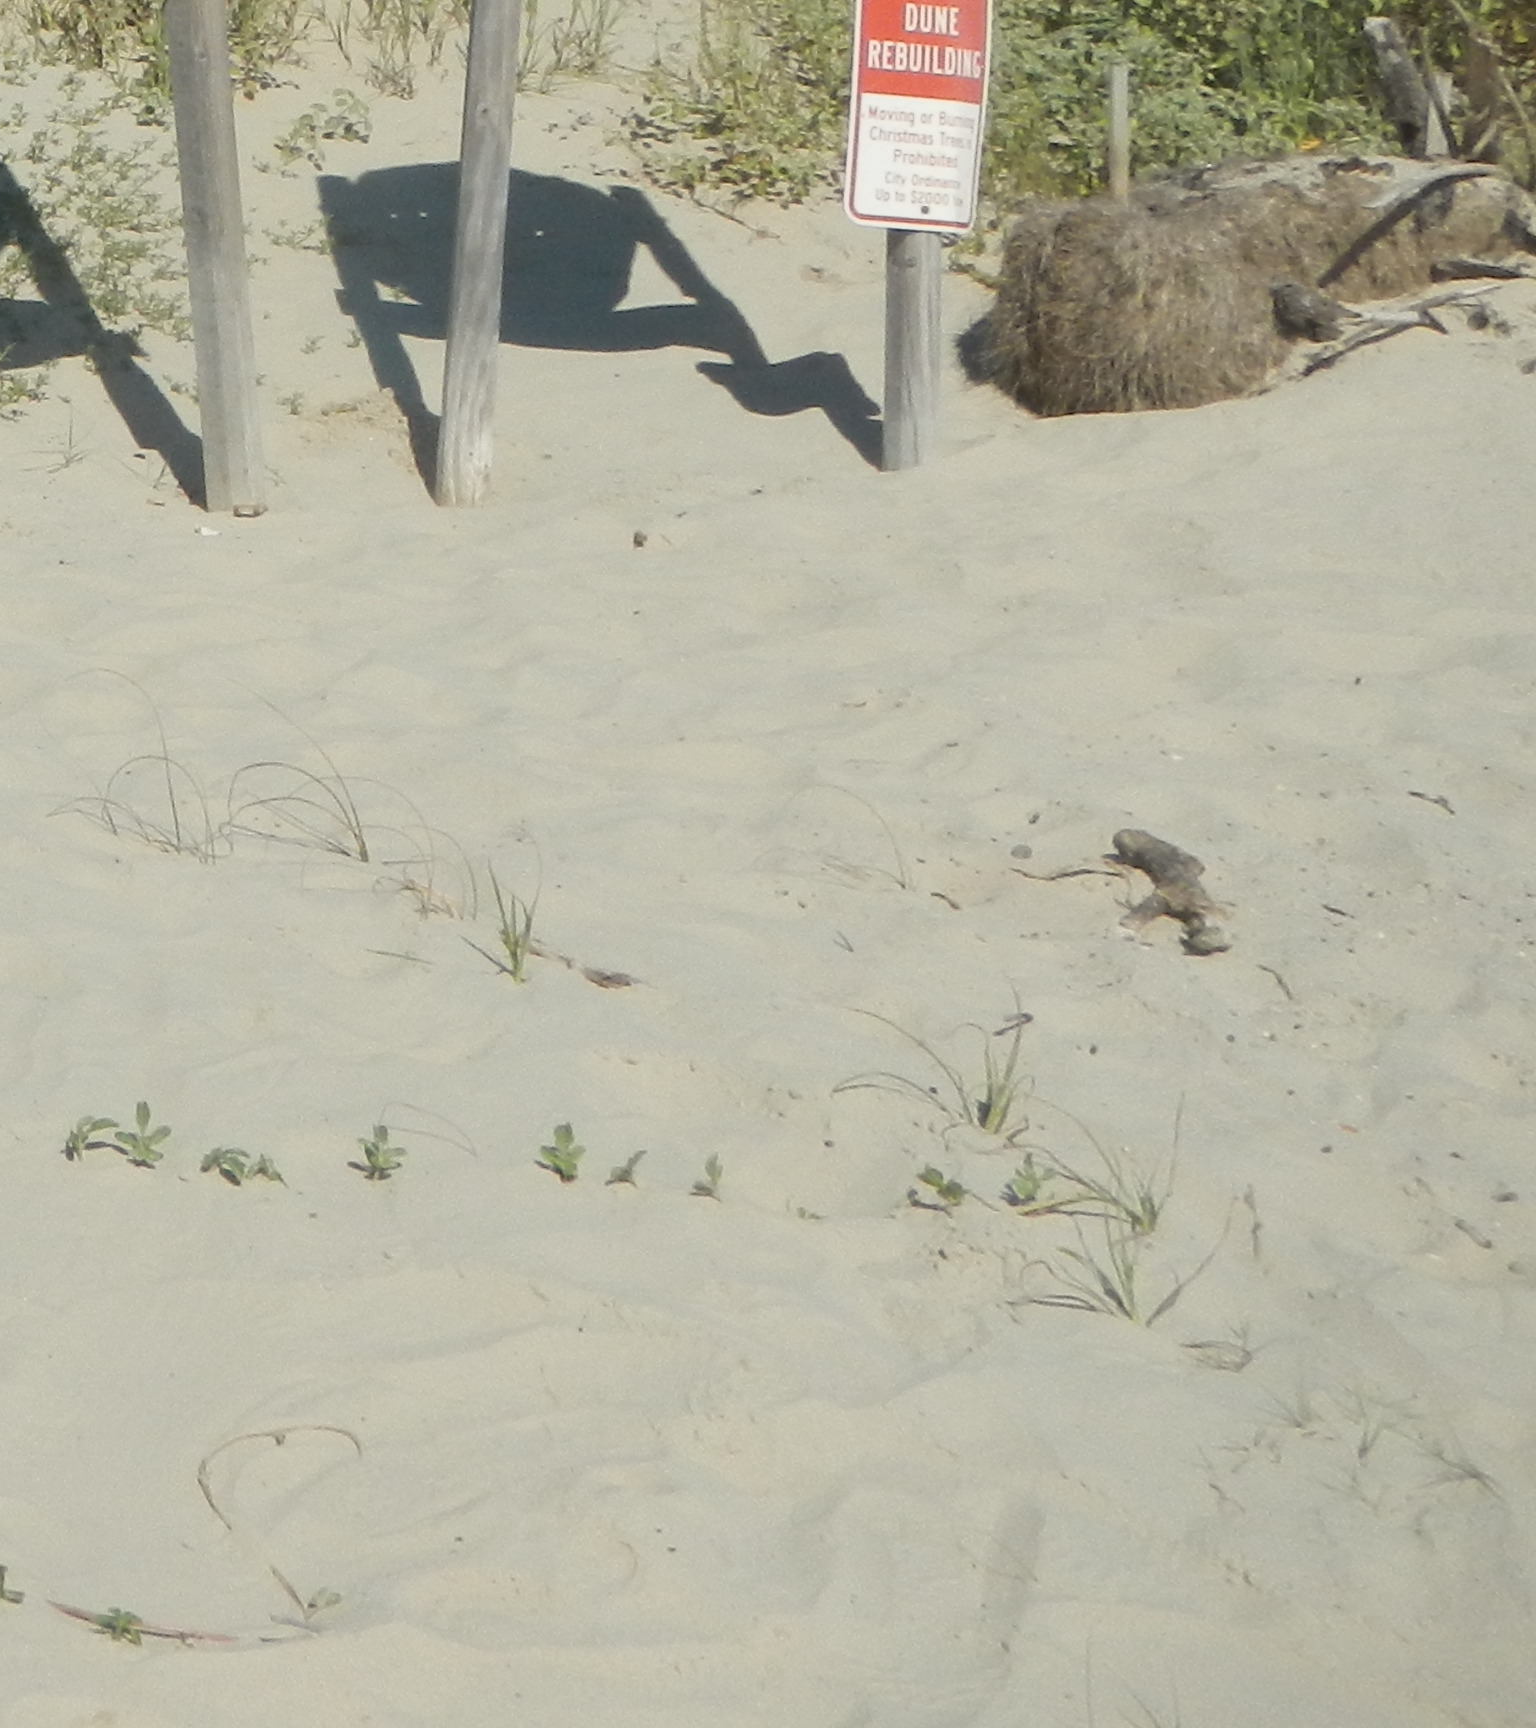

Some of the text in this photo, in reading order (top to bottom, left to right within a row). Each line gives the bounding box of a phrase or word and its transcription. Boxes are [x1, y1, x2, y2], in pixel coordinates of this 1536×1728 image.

[905, 3, 959, 36] DUNE
[868, 39, 981, 78] REBUILDING
[868, 105, 915, 127] Moving
[920, 113, 933, 124] or
[869, 125, 934, 145] Christmas
[893, 149, 958, 168] Prohibited
